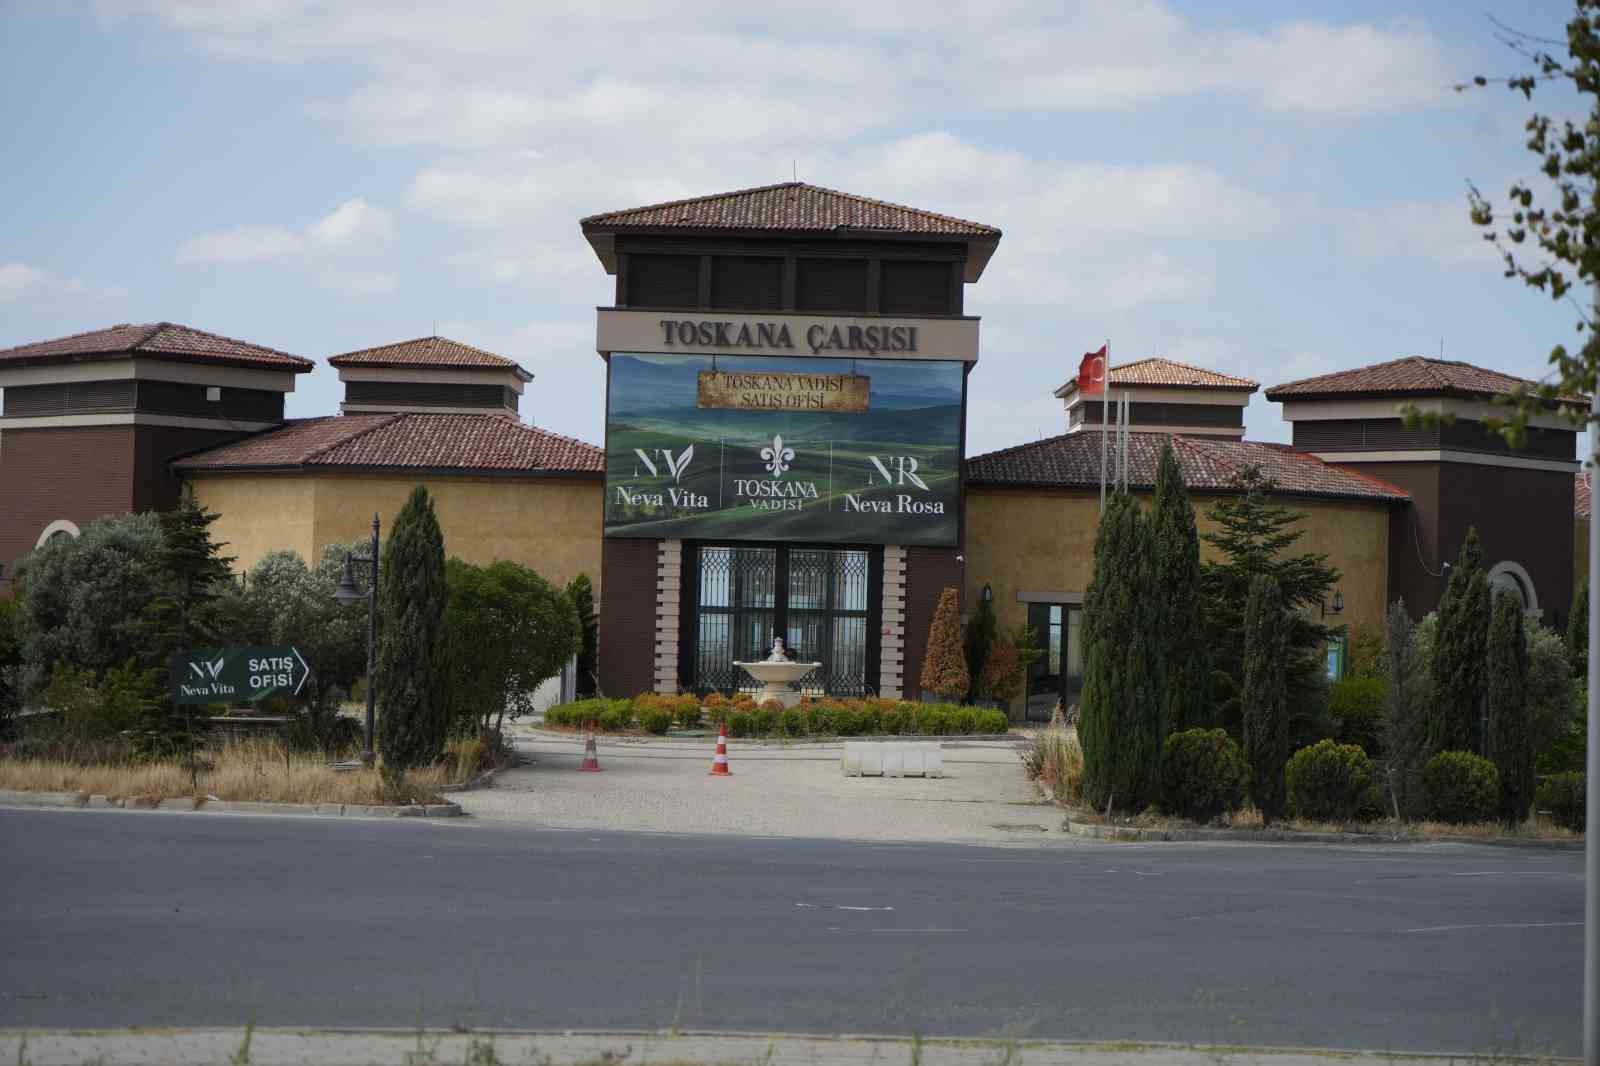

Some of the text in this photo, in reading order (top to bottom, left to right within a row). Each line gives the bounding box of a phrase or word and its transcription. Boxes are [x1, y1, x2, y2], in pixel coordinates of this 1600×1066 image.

[660, 320, 919, 355] TOSKANA ÇARŞISI
[724, 375, 844, 392] TOSKANA VADİSİ
[742, 391, 825, 409] SATIŞ OFİSİ
[614, 486, 709, 508] Neva Vita
[734, 479, 819, 498] TOSKANA
[842, 493, 945, 514] Neva Rosa
[249, 657, 293, 672] SATIŞ
[181, 681, 235, 697] Neva Vita
[250, 674, 293, 688] OFİSİ
